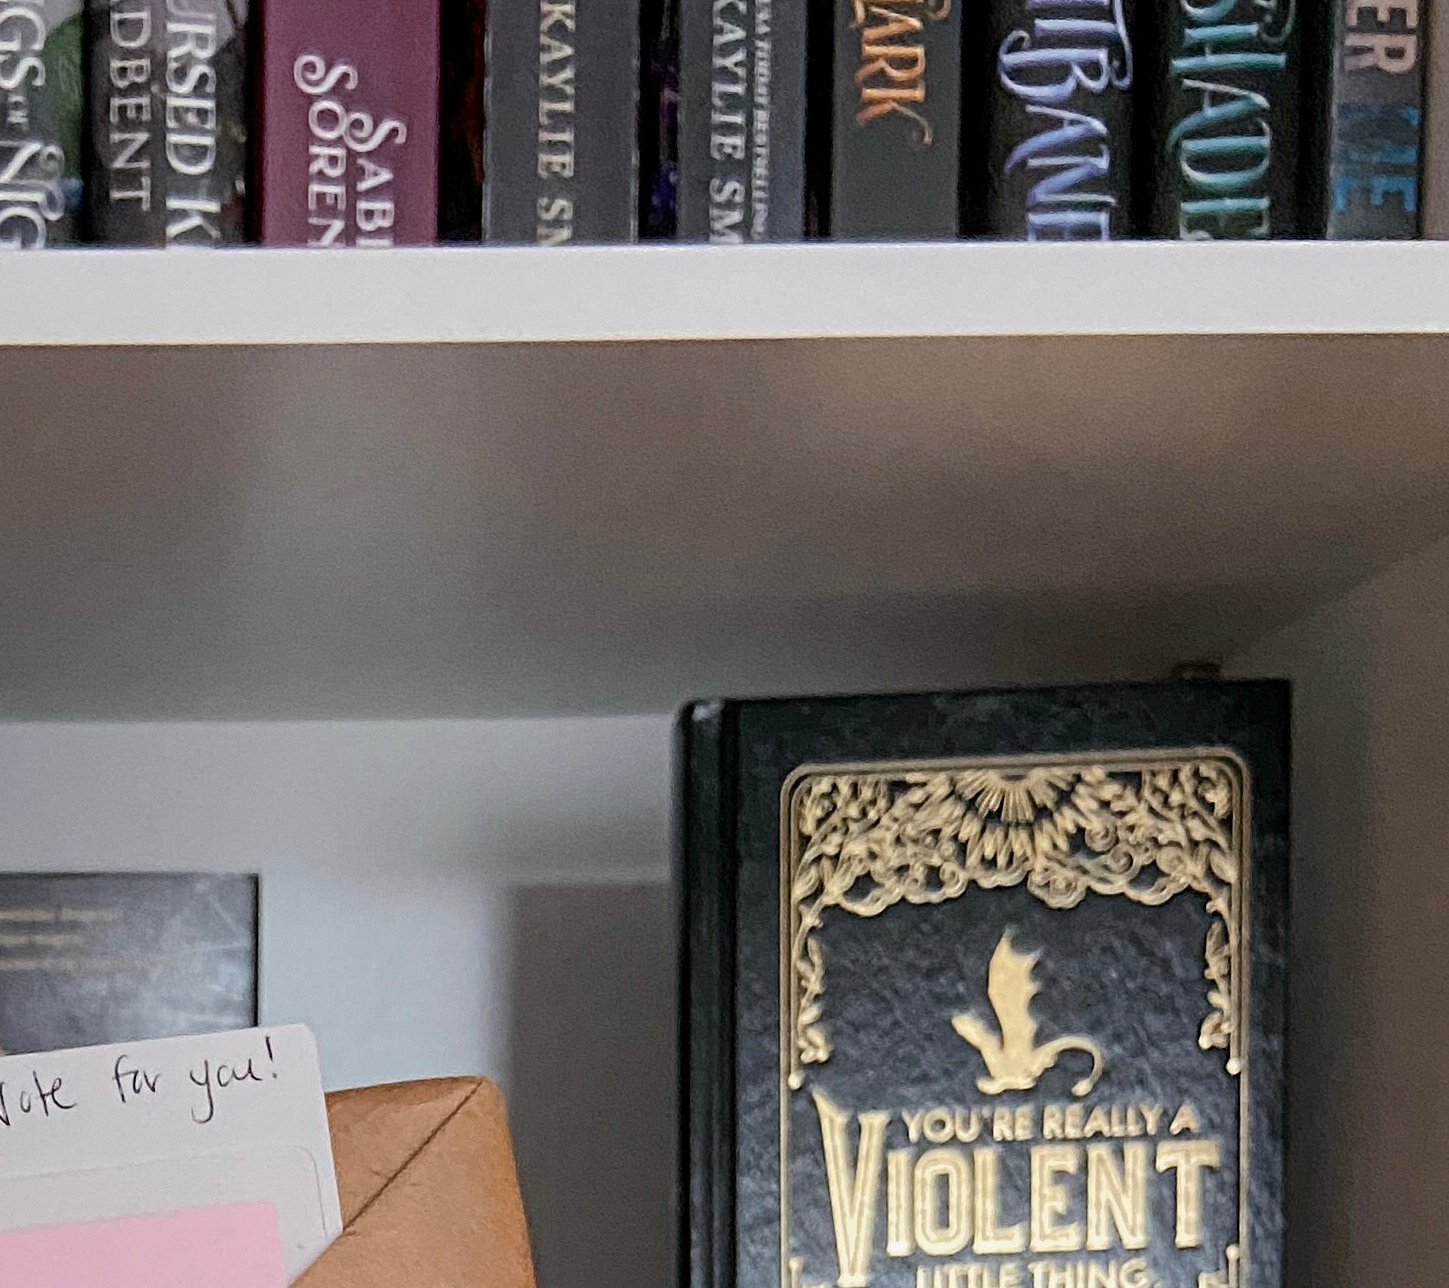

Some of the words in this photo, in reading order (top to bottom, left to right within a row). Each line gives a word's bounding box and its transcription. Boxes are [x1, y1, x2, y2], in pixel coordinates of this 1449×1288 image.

[108, 0, 152, 212] DBENT
[538, 0, 577, 178] KAYLIE
[854, 0, 934, 147] ARK
[996, 0, 1134, 241] TBANE
[111, 1054, 162, 1105] for
[188, 1035, 280, 1125] you!
[901, 1104, 1034, 1145] YOU'RE
[1041, 1102, 1166, 1141] REALLY
[1168, 1102, 1203, 1137] A
